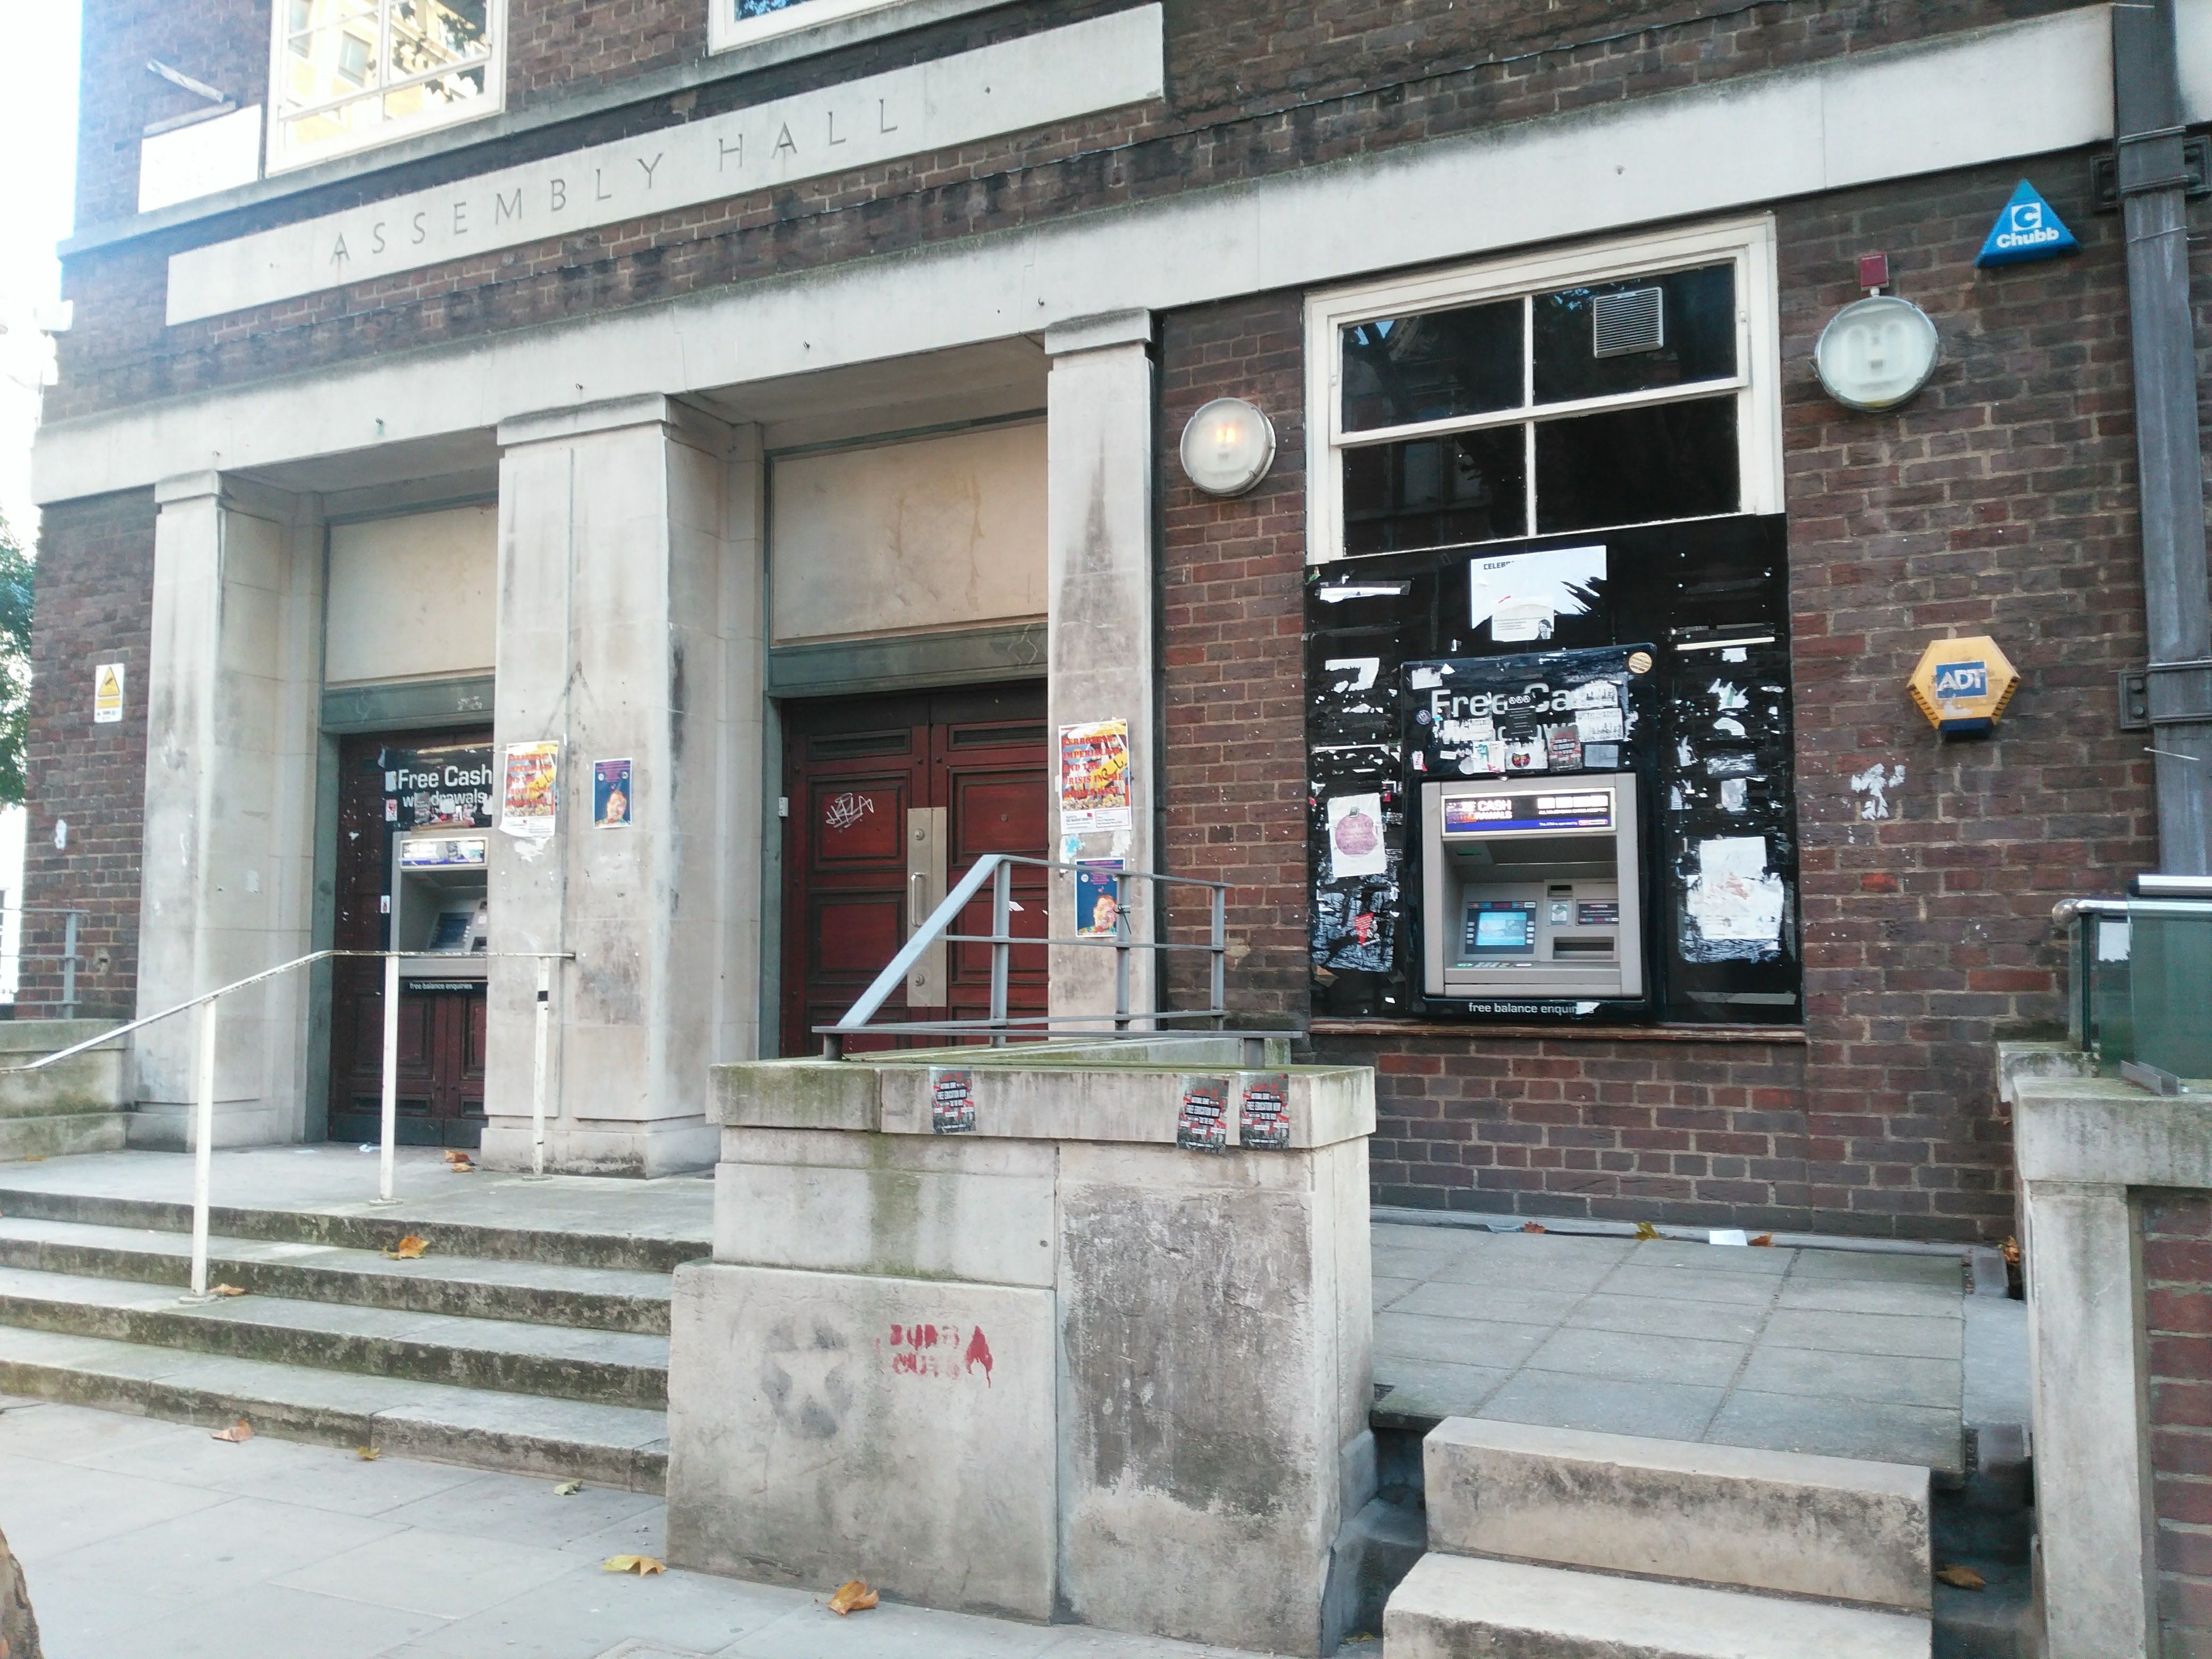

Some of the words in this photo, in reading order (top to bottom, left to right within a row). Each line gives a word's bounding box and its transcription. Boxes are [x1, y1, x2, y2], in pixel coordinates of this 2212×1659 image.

[330, 153, 664, 265] ASSEMBLY
[719, 99, 899, 172] HALL
[1996, 227, 2060, 248] Chubb
[1938, 668, 1986, 691] ADT
[1431, 689, 1506, 719] Free
[1524, 683, 1572, 713] Ca
[398, 769, 439, 790] Free
[445, 764, 492, 787] Cash
[403, 788, 485, 808] wdrawals
[1478, 799, 1511, 811] CASH
[1469, 1002, 1492, 1012] free
[1494, 1002, 1538, 1013] balance
